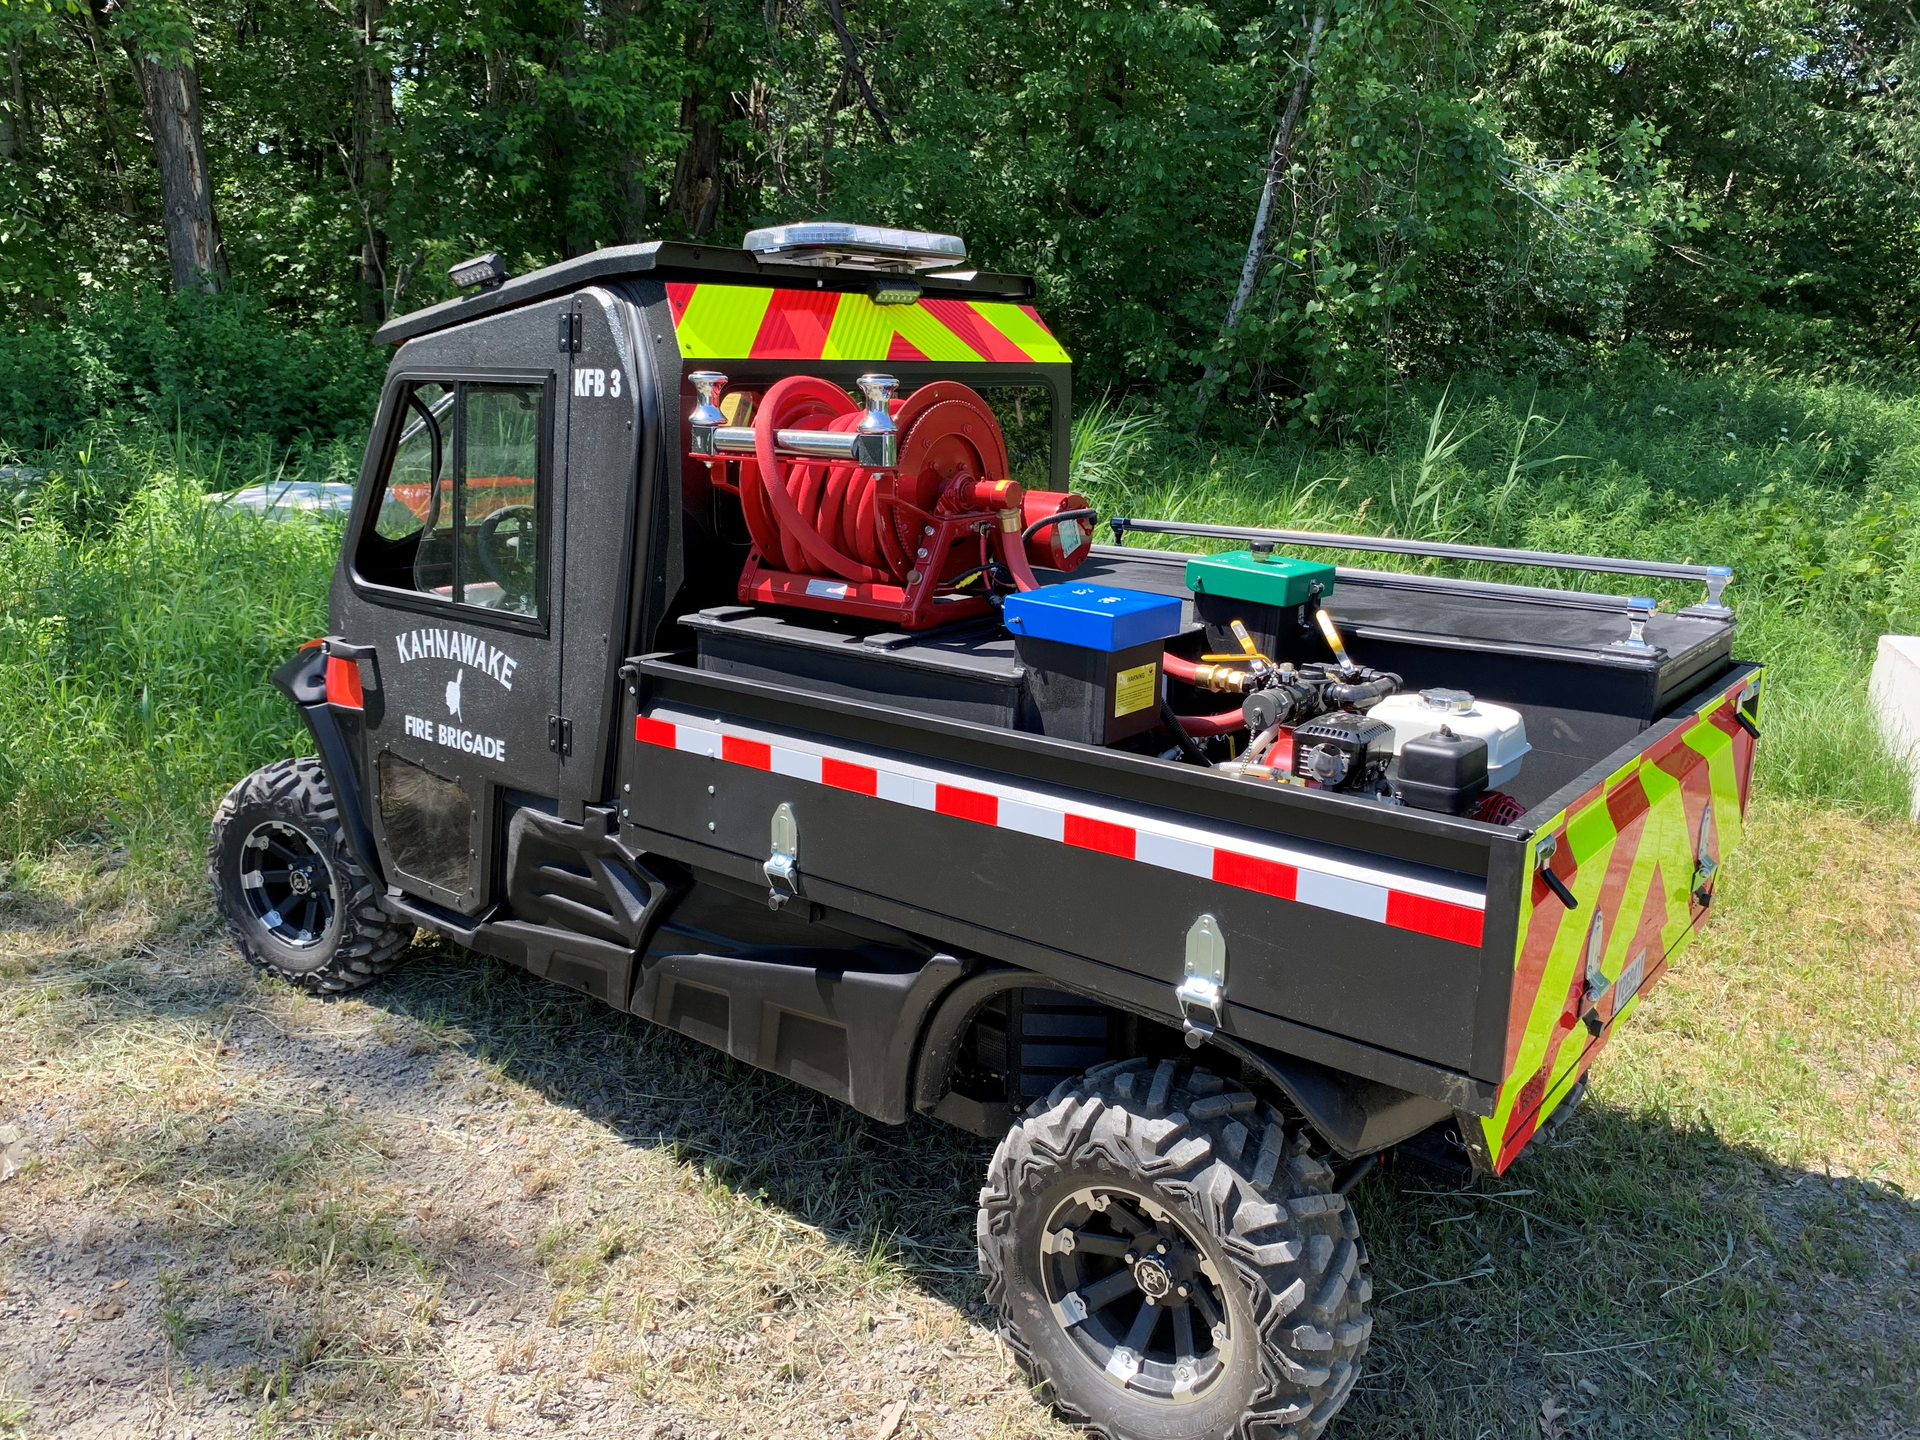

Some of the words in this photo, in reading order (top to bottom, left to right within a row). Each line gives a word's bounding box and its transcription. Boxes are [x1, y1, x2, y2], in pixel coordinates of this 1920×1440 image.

[574, 368, 605, 397] KFB
[610, 368, 621, 398] 3
[395, 628, 518, 691] KAHNAWAKE
[405, 714, 433, 742] FIRE
[438, 723, 505, 762] BRIGADE
